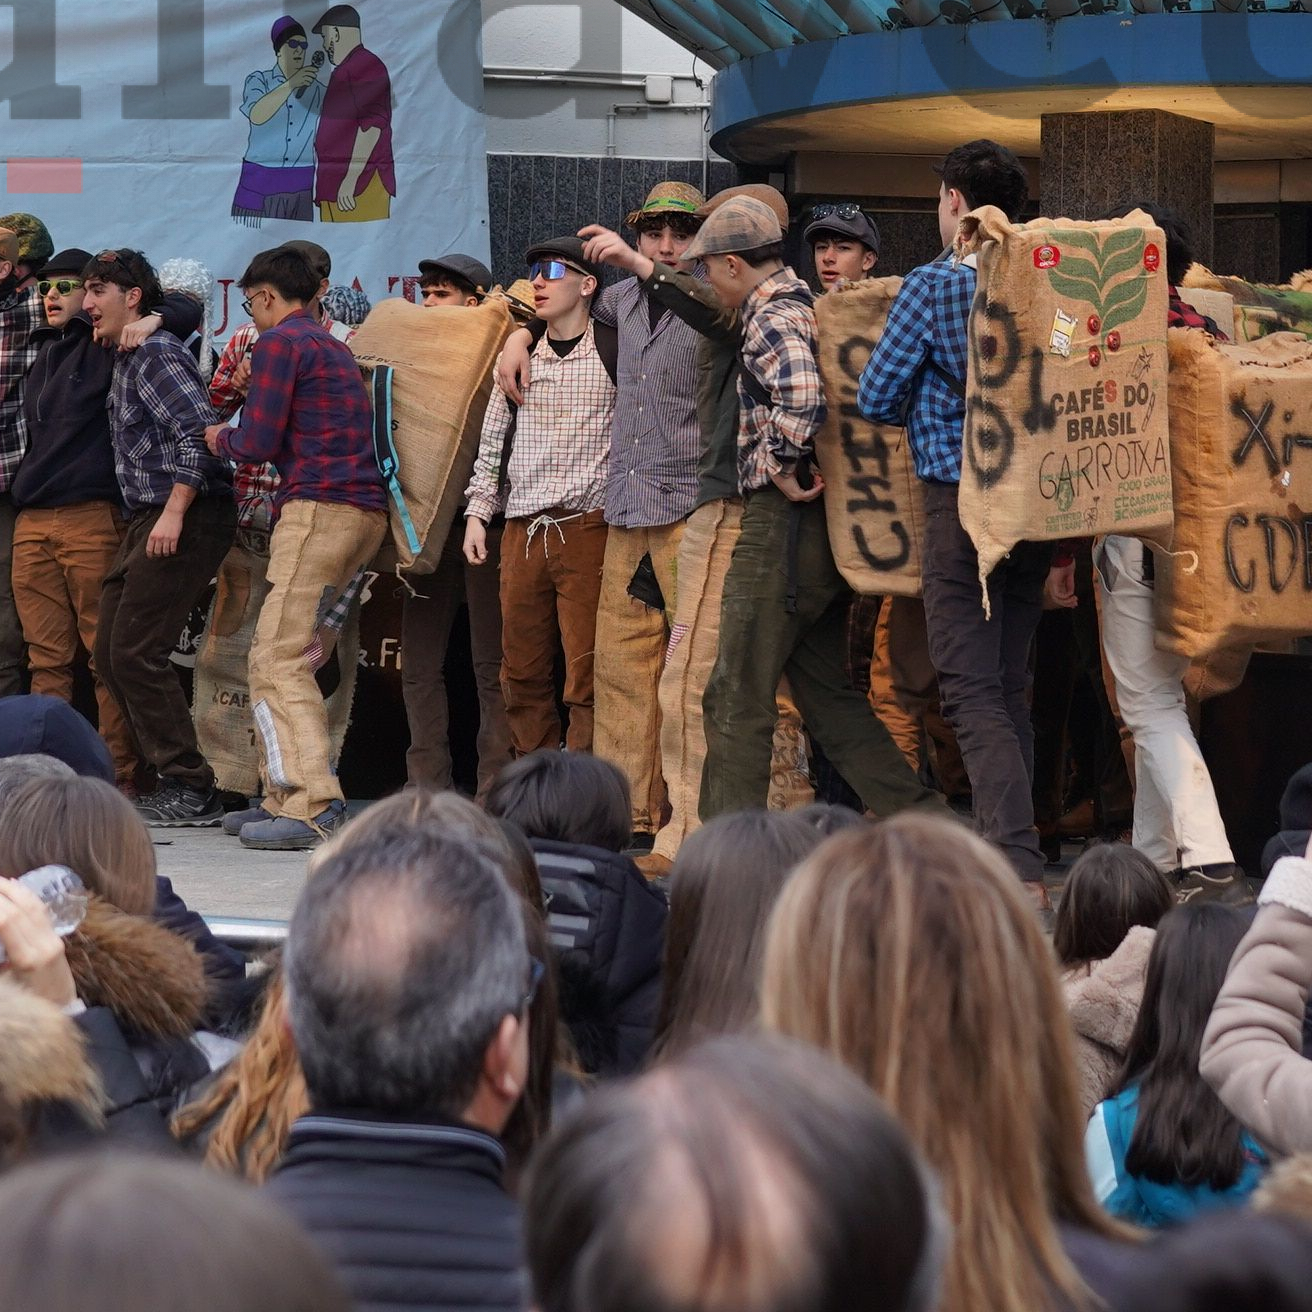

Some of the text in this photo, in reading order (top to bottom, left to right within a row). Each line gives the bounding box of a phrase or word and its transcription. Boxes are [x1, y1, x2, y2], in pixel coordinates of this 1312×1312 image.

[1124, 382, 1149, 408] DO
[1067, 411, 1137, 443] BRASIL
[1039, 437, 1167, 500] GARROTXA
